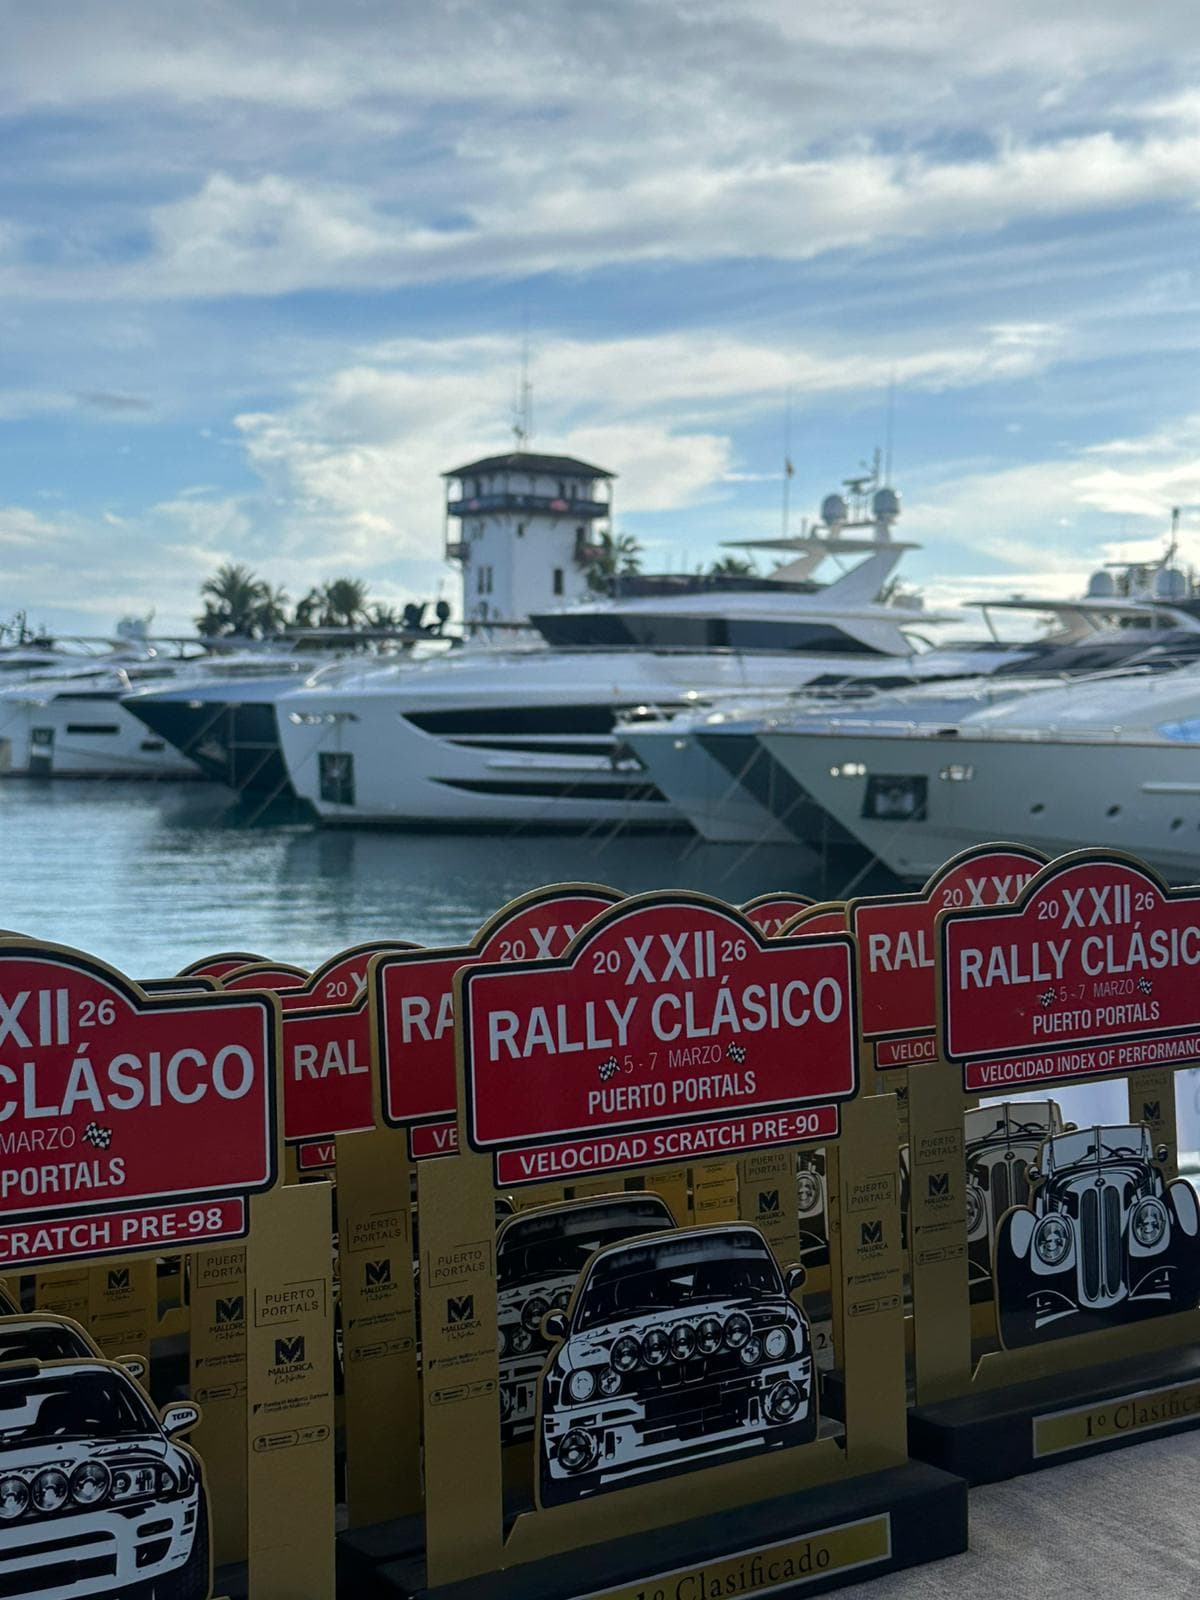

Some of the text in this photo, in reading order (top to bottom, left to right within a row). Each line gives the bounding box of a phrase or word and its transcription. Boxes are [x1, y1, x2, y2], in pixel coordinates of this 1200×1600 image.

[943, 873, 1033, 907] 20 XXI
[1038, 884, 1155, 930] 20 XXII 26
[499, 940, 526, 962] 20
[592, 930, 747, 986] 20 XXII 26
[960, 939, 1071, 990] RALLY
[325, 981, 348, 999] 20
[1093, 978, 1135, 999] MARZO
[78, 999, 116, 1028] 26
[488, 974, 842, 1062] RALLY CLÁSICO
[1032, 1001, 1161, 1035] PUERTO PORTALS
[668, 1044, 722, 1069] MARZO
[980, 1058, 1055, 1083] VELOCIDAD
[1057, 1051, 1096, 1073] INDEX
[1098, 1050, 1116, 1067] OF
[588, 1070, 758, 1115] PUERTO PORTALS
[520, 1113, 820, 1176] VELOCIDAD SCRATCH PRE-90
[1, 1157, 126, 1198] PORTALS
[853, 1181, 889, 1194] PUERTO
[121, 1207, 223, 1242] PRE-98
[352, 1227, 402, 1245] PORTALS
[355, 1217, 399, 1233] PUERTO
[434, 1261, 486, 1279] PORTALS
[437, 1249, 483, 1265] PUERTO
[261, 1299, 320, 1319] PORTALS
[264, 1287, 316, 1305] PUERTO
[267, 1361, 314, 1377] MALLORCA
[676, 1542, 831, 1600] Clasificado
